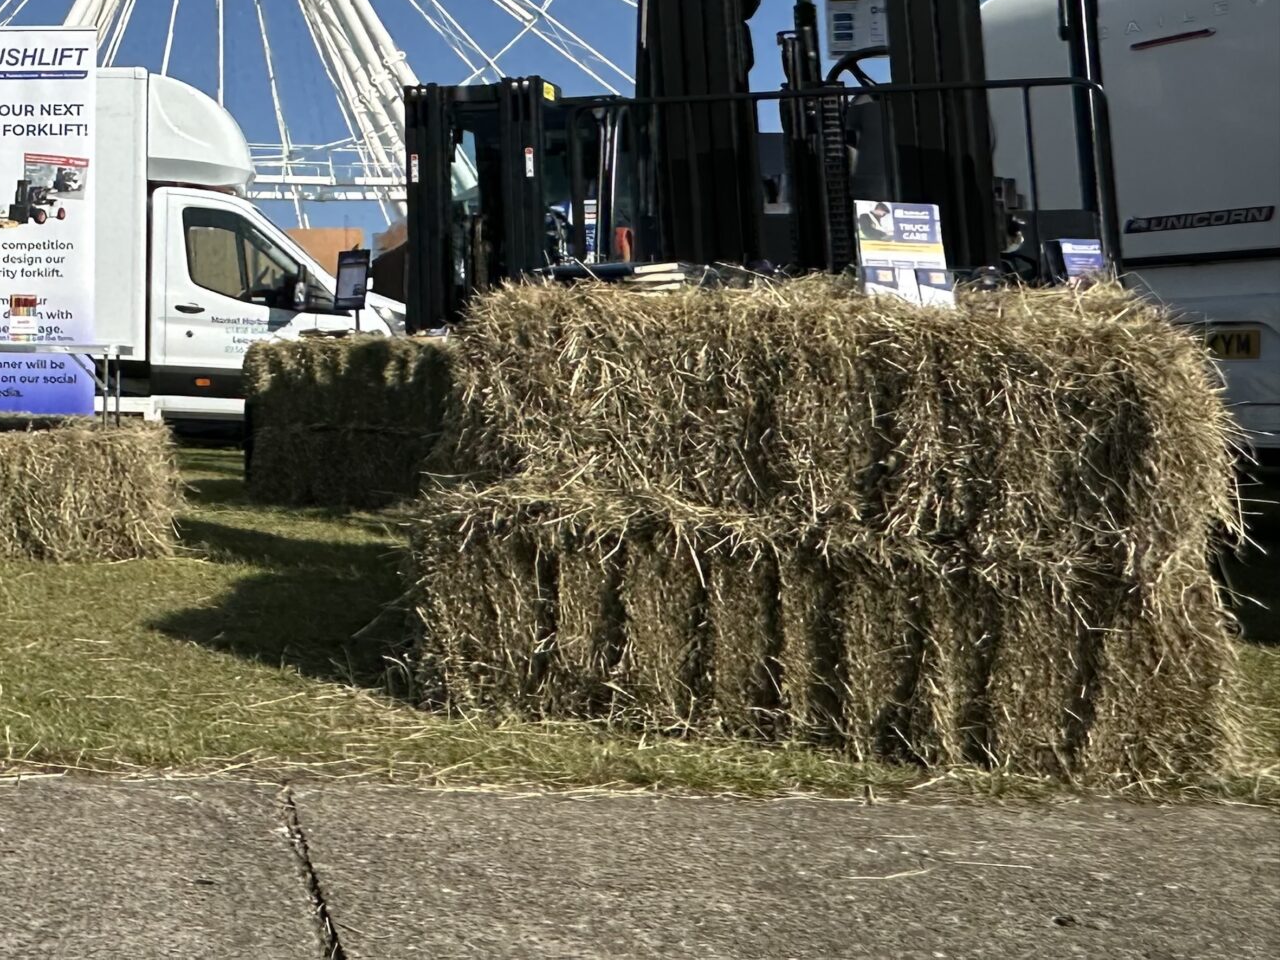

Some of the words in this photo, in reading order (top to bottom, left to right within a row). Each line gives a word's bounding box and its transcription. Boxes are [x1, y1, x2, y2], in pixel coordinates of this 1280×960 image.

[40, 104, 84, 116] NEXT
[2, 124, 88, 136] FORKLIFT!
[1150, 206, 1270, 231] UNICORN
[1, 240, 74, 253] competition
[3, 254, 42, 267] design
[46, 256, 66, 264] our
[21, 268, 63, 278] forklift.
[46, 309, 73, 320] with
[26, 359, 47, 369] will
[50, 359, 65, 369] be
[1, 375, 16, 383] on
[20, 375, 40, 383] our
[43, 372, 77, 384] social
